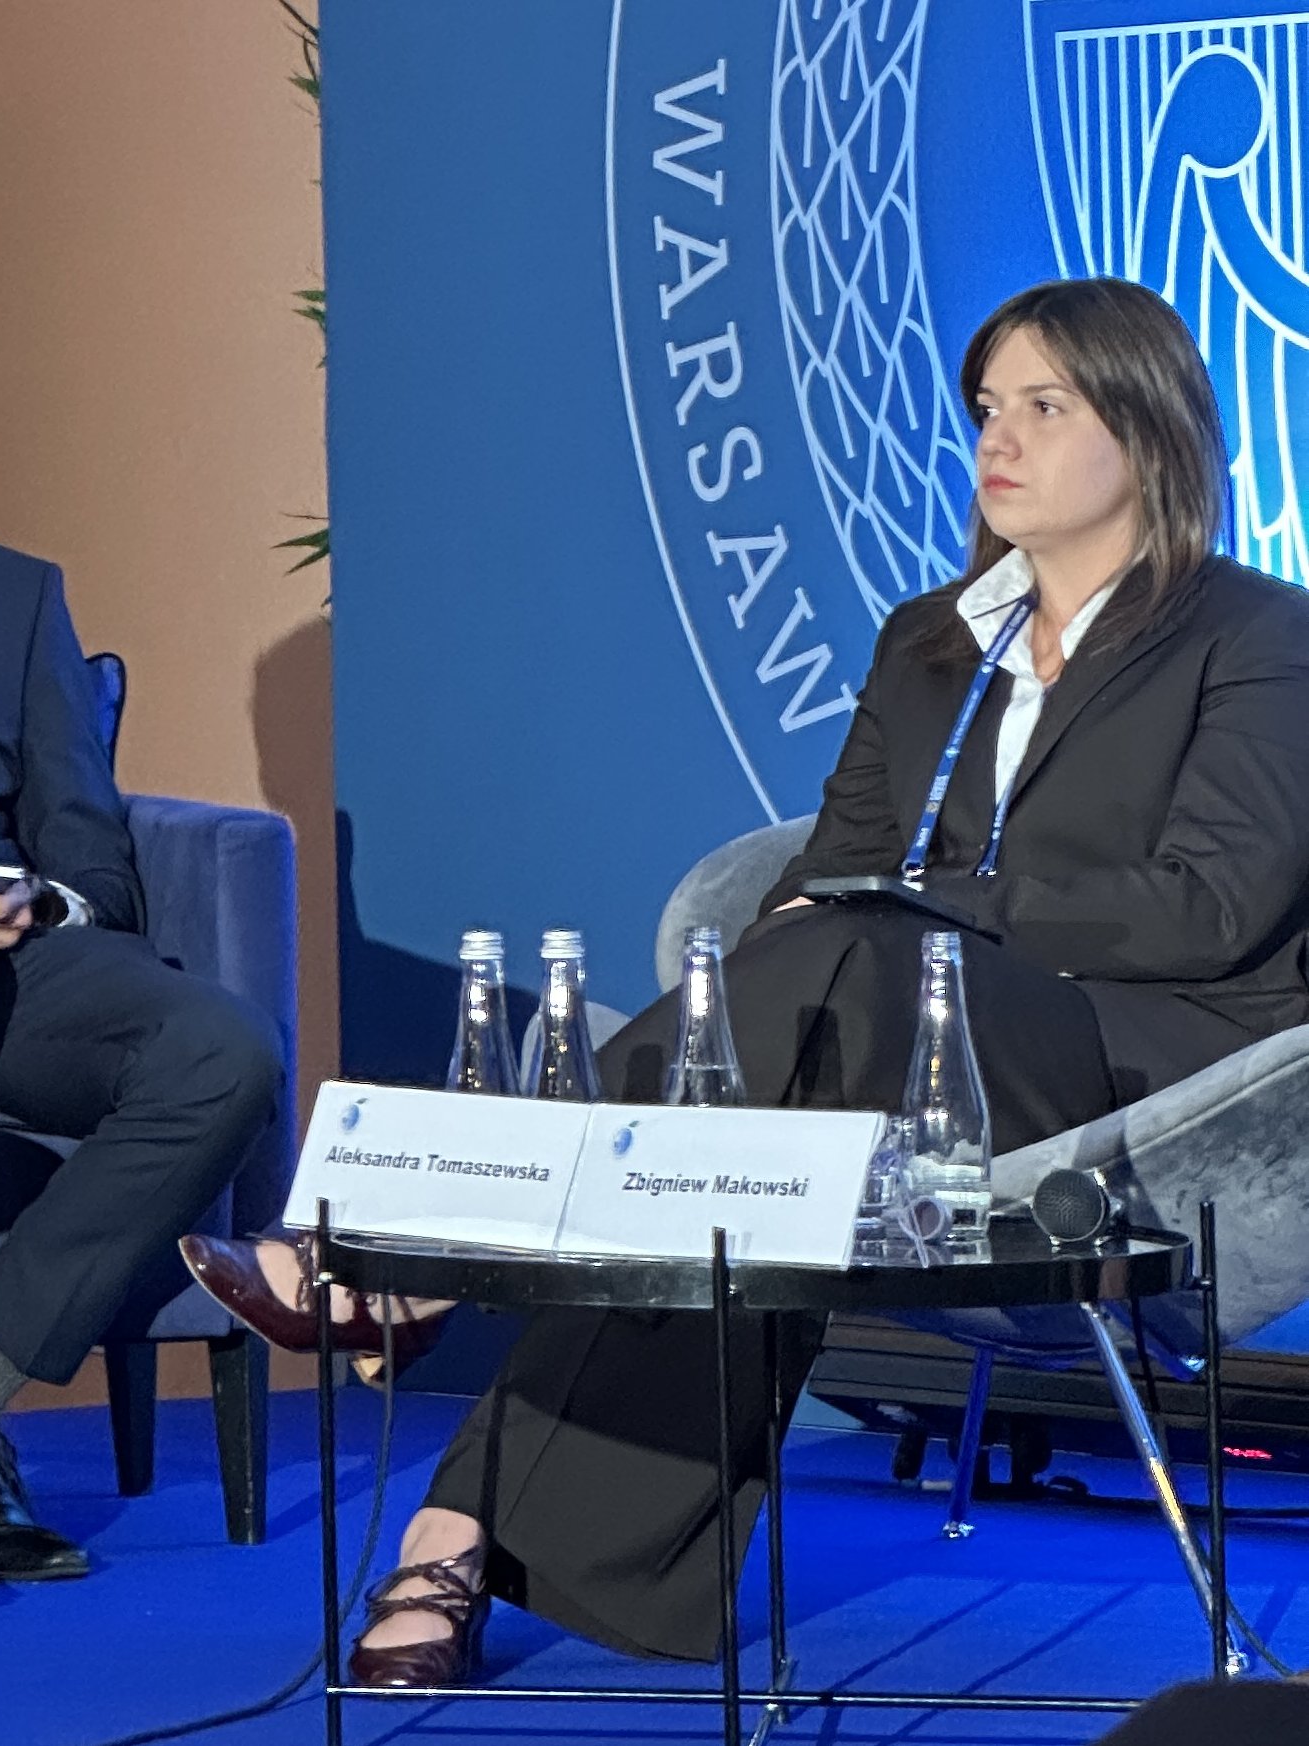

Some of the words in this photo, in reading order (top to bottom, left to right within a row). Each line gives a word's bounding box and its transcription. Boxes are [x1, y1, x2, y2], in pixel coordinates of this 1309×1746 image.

[653, 59, 859, 733] WARSAW
[324, 1145, 421, 1170] Aleksandra
[426, 1153, 551, 1182] Tomaszewska
[621, 1172, 709, 1196] Zbigniew
[711, 1174, 810, 1197] Makowski
